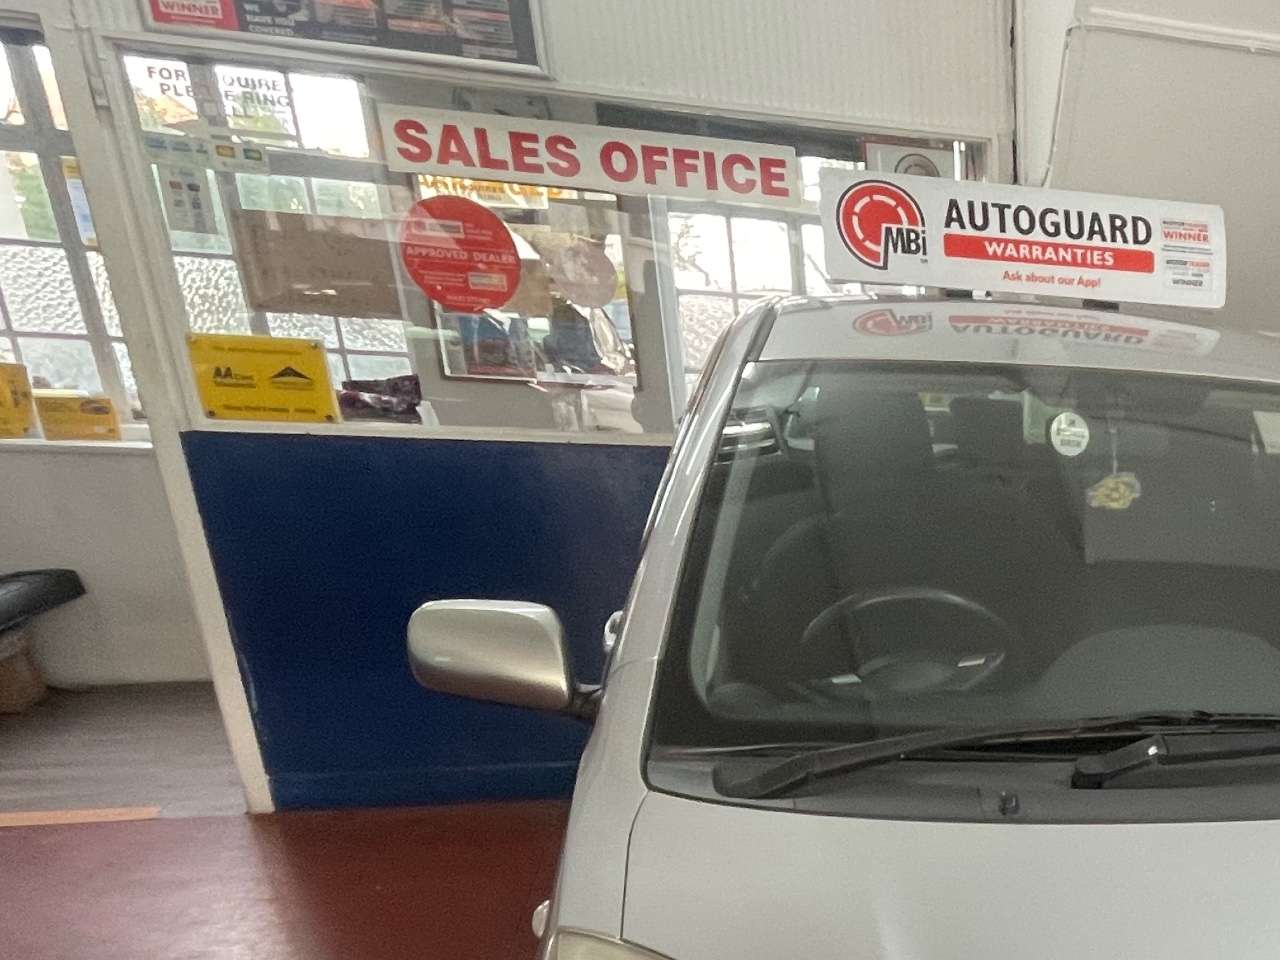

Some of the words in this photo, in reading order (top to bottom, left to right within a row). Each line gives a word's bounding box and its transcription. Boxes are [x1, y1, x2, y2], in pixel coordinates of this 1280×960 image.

[161, 1, 219, 17] WINNER
[146, 66, 187, 82] FOR
[394, 119, 581, 178] SALES
[601, 141, 790, 198] OFFICE
[944, 198, 1152, 246] AUTOGUARD
[884, 226, 928, 256] MBi
[1163, 230, 1209, 243] WINNER
[406, 246, 468, 260] APPROVED
[472, 252, 516, 265] DEALER
[984, 241, 1115, 266] WARRANTIES
[1003, 271, 1022, 281] Ask
[1025, 270, 1055, 285] about
[1057, 277, 1075, 286] our
[1077, 276, 1102, 289] App!
